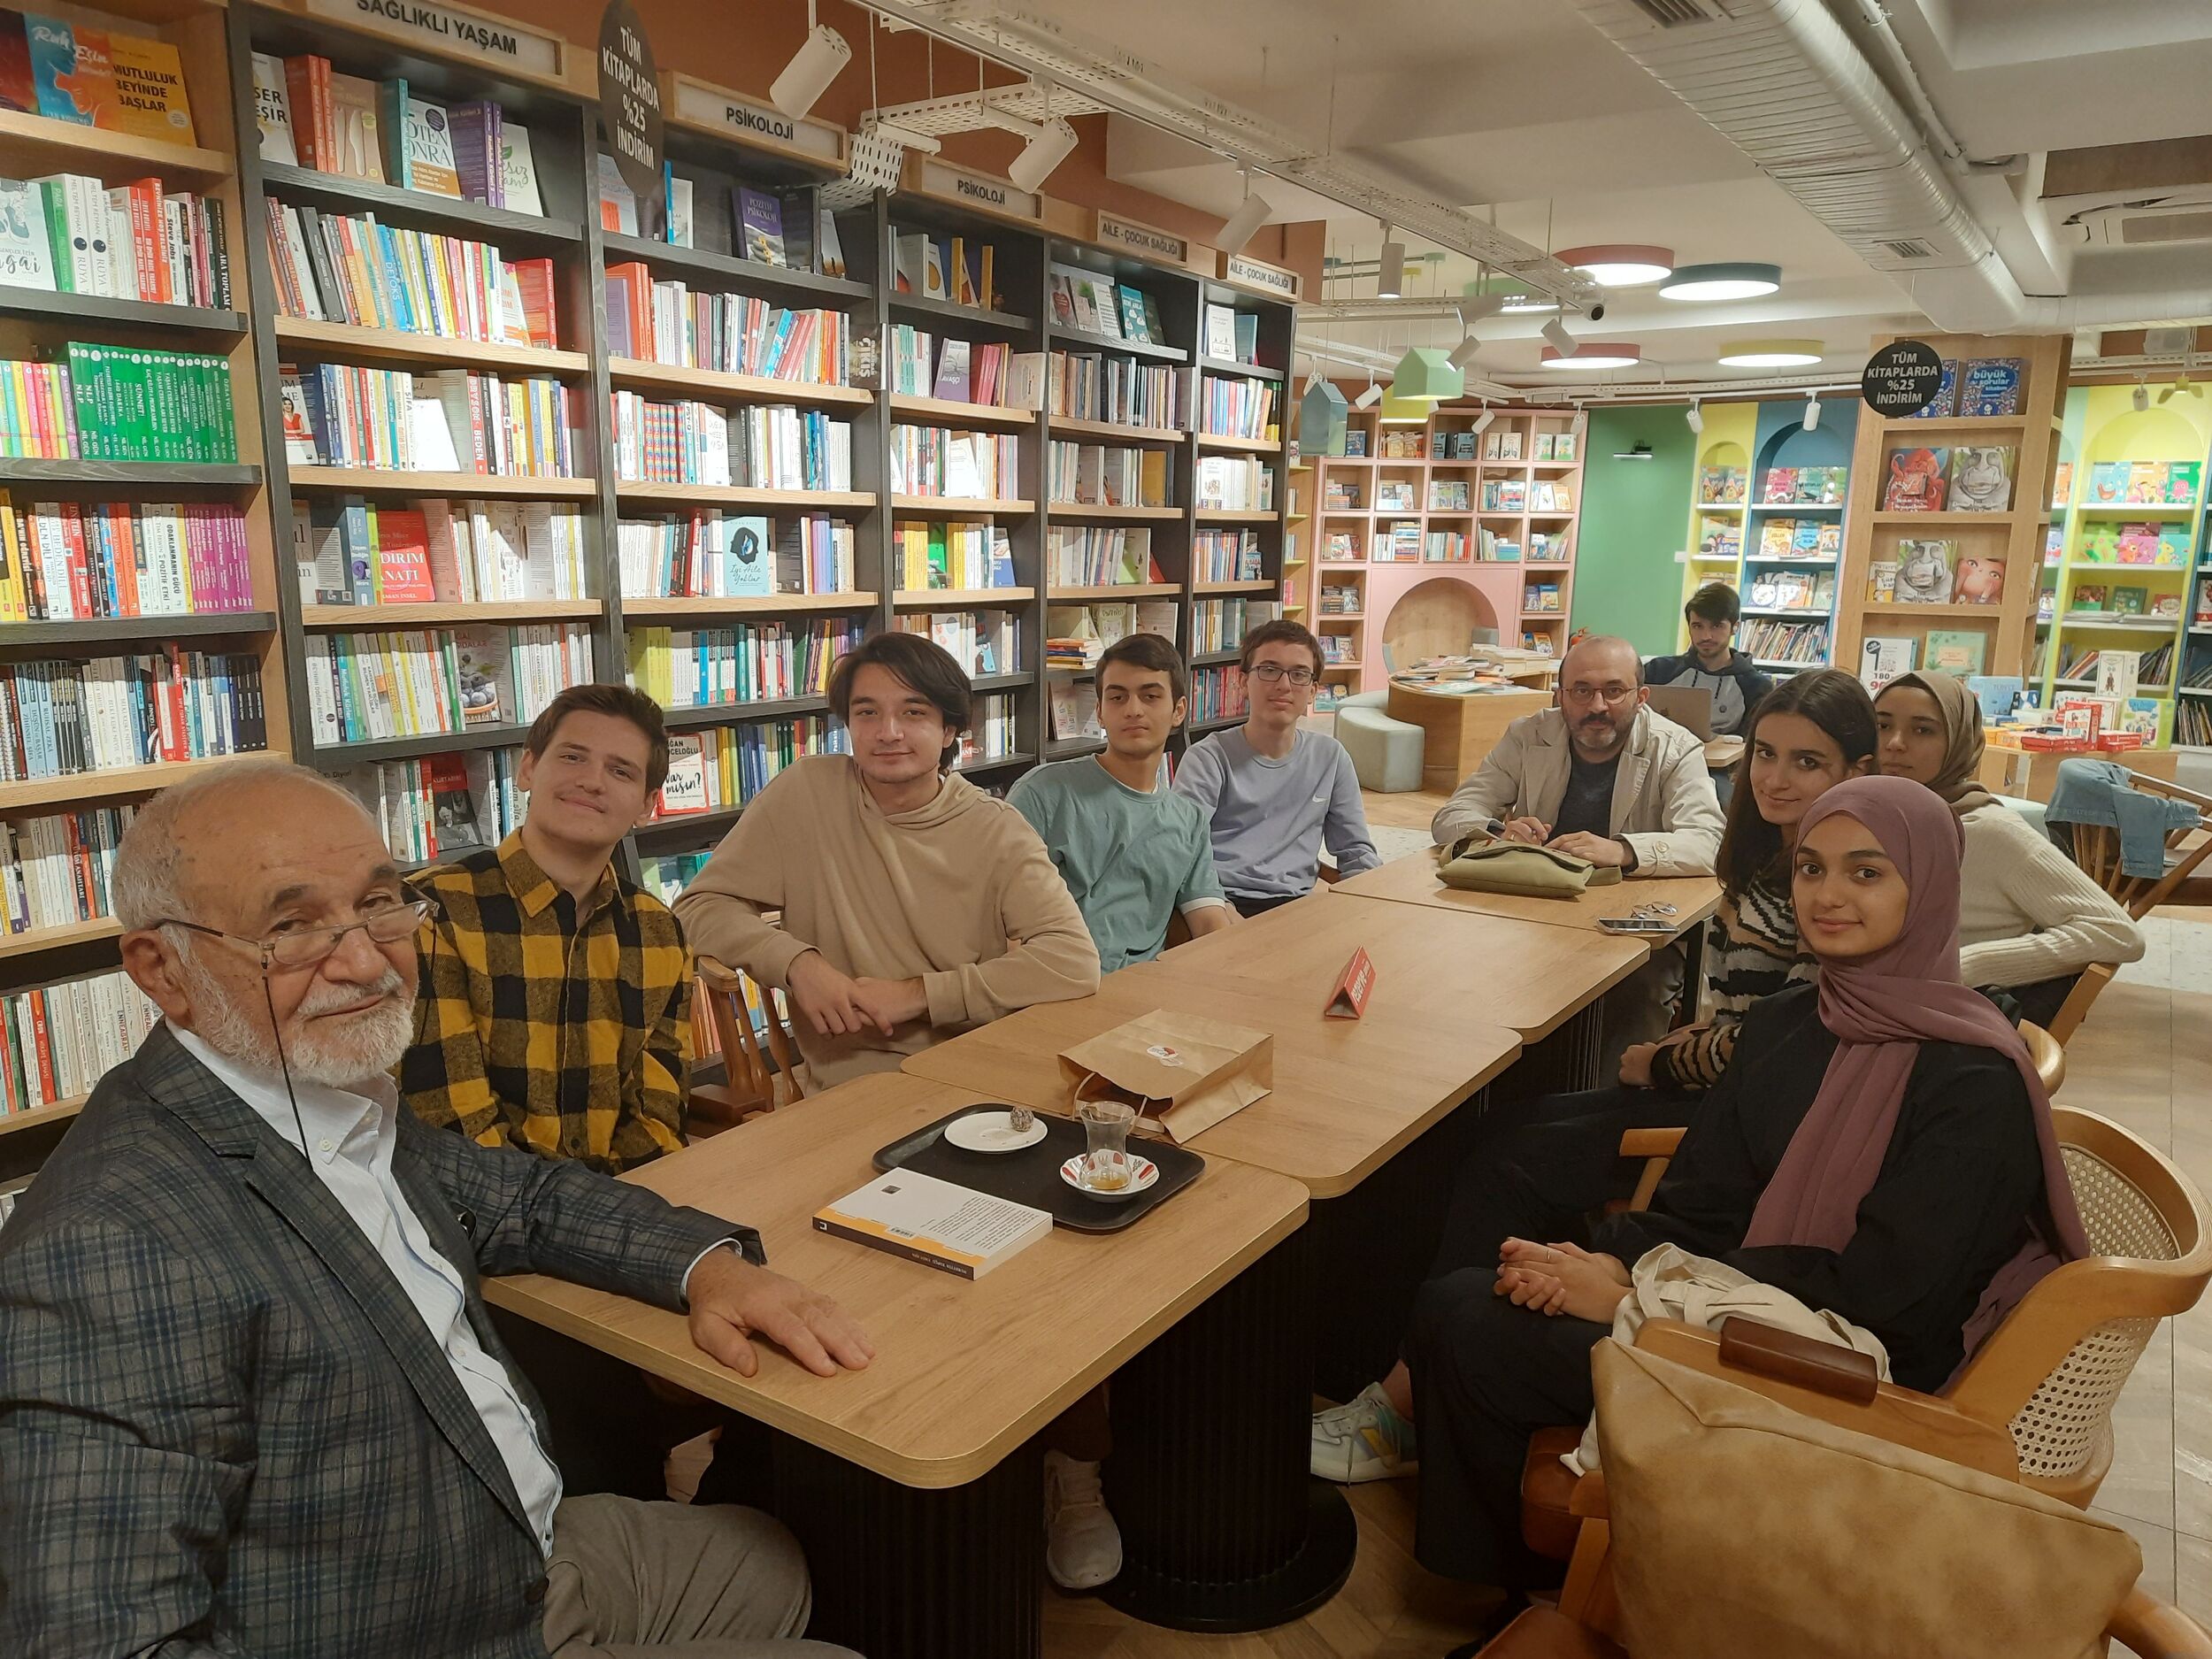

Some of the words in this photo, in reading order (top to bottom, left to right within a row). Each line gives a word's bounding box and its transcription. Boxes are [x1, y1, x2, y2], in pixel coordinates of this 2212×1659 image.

[453, 19, 518, 55] YAŞAM
[620, 27, 641, 65] TÜM
[603, 47, 660, 111] KİTAPLARDA
[623, 94, 646, 132] %25
[726, 107, 794, 140] PSİKOLOJİ
[617, 119, 654, 170] İNDİRİM
[957, 180, 1005, 205] PSİKOLOJİ
[1102, 220, 1118, 237] AİLE
[1125, 231, 1149, 248] ÇOCUK
[1150, 237, 1177, 255] SAĞLIĞI
[219, 253, 228, 269] ARA
[1230, 261, 1242, 273] AİLE
[1248, 267, 1266, 281] ÇOCUK
[1268, 273, 1288, 289] SAĞLIĞI
[221, 272, 230, 305] TOPLAM
[386, 263, 400, 301] DETOKS
[857, 337, 871, 378] ÇIKIŞ
[1867, 365, 1938, 379] KİTAPLARDA
[1892, 351, 1916, 364] TÜM
[1887, 380, 1915, 390] %25
[1973, 370, 2007, 382] büyük
[1979, 378, 2009, 388] sorular
[75, 384, 84, 403] NLP
[135, 383, 144, 416] SÜNNET!
[1877, 393, 1923, 404] İNDİRİM
[474, 430, 484, 460] BEDEN
[70, 506, 81, 536] EINSTEIN
[53, 534, 65, 567] BEDEN
[167, 525, 177, 574] ODAKLANMANIN
[55, 570, 67, 588] DİLİ
[730, 563, 742, 573] İyi
[743, 565, 762, 573] Aile
[733, 572, 761, 585] Yoktur
[341, 669, 349, 697] Mutluluk
[22, 714, 31, 744] ZİHİNSEL
[74, 866, 85, 898] ANAHTARI
[117, 1010, 128, 1052] ENNEAGRAM
